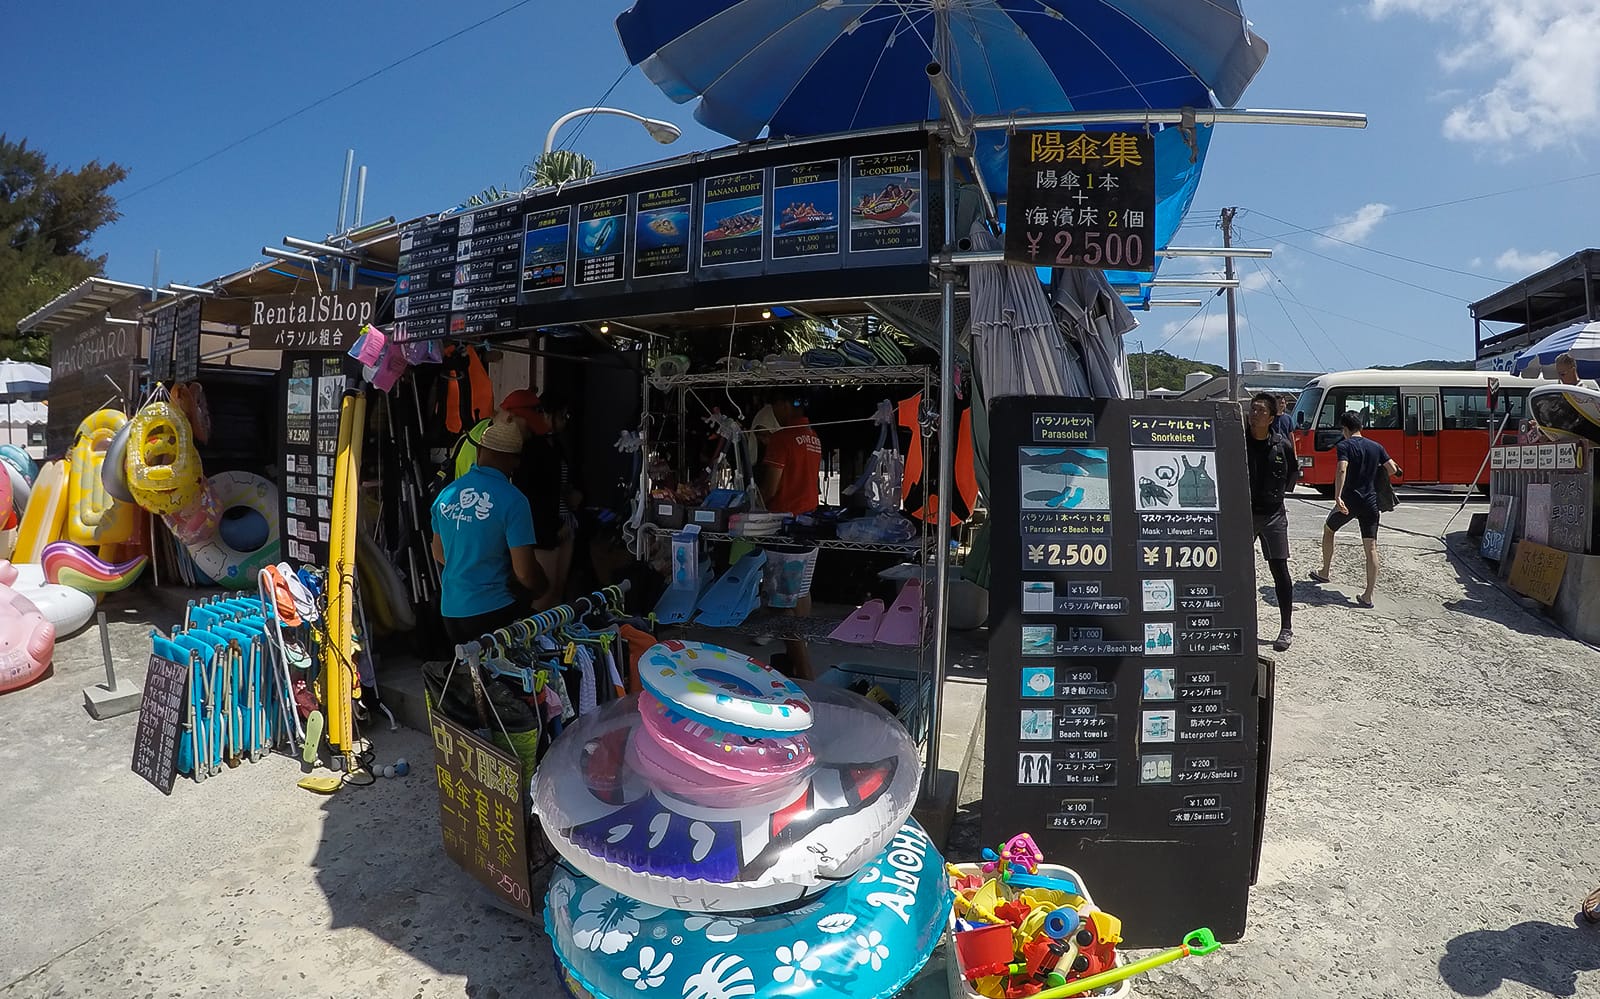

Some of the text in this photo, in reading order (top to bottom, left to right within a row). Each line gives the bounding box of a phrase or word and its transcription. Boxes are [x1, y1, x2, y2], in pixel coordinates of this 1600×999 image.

[1030, 131, 1143, 168] 陽傘集
[792, 174, 820, 184] BETTY
[707, 184, 739, 198] BANANA
[252, 294, 371, 326] RentalShop
[275, 328, 344, 346] パラソル組合
[1035, 416, 1093, 427] パラソルセット
[1131, 419, 1212, 430] シュノーケルセット
[1042, 429, 1088, 440] Parasolset
[1151, 432, 1195, 443] Snorkelset
[1141, 513, 1214, 523] マスク・フィン・ジャケット
[1199, 526, 1214, 535] Fins
[1028, 544, 1107, 566] ¥2,500
[1143, 546, 1218, 568] ¥1,200
[1190, 587, 1209, 596] ¥500
[1059, 601, 1122, 611] パラソル/Parasol
[1180, 599, 1221, 609] マスク/Mask
[1191, 618, 1210, 627] ¥500
[1180, 631, 1239, 641] ライフジャケット
[1129, 644, 1143, 653] bed
[1189, 643, 1206, 653] Life
[1071, 672, 1092, 681] ¥500
[1191, 674, 1210, 683] ¥500
[1181, 686, 1223, 697] フィン/Fins
[1070, 706, 1091, 715] ¥500
[1058, 718, 1106, 727] ビーチタオル
[1190, 718, 1228, 728] 防水ケース
[1059, 729, 1108, 739] Beach towels
[1180, 730, 1237, 739] Waterproof case
[1191, 759, 1210, 768] ¥200
[1066, 774, 1100, 783] Wet suit
[1067, 803, 1087, 812] ¥100
[1053, 817, 1102, 826] おもちゃ/Toy
[1175, 812, 1225, 822] 水着/Swimsuit
[671, 895, 721, 912] PK
